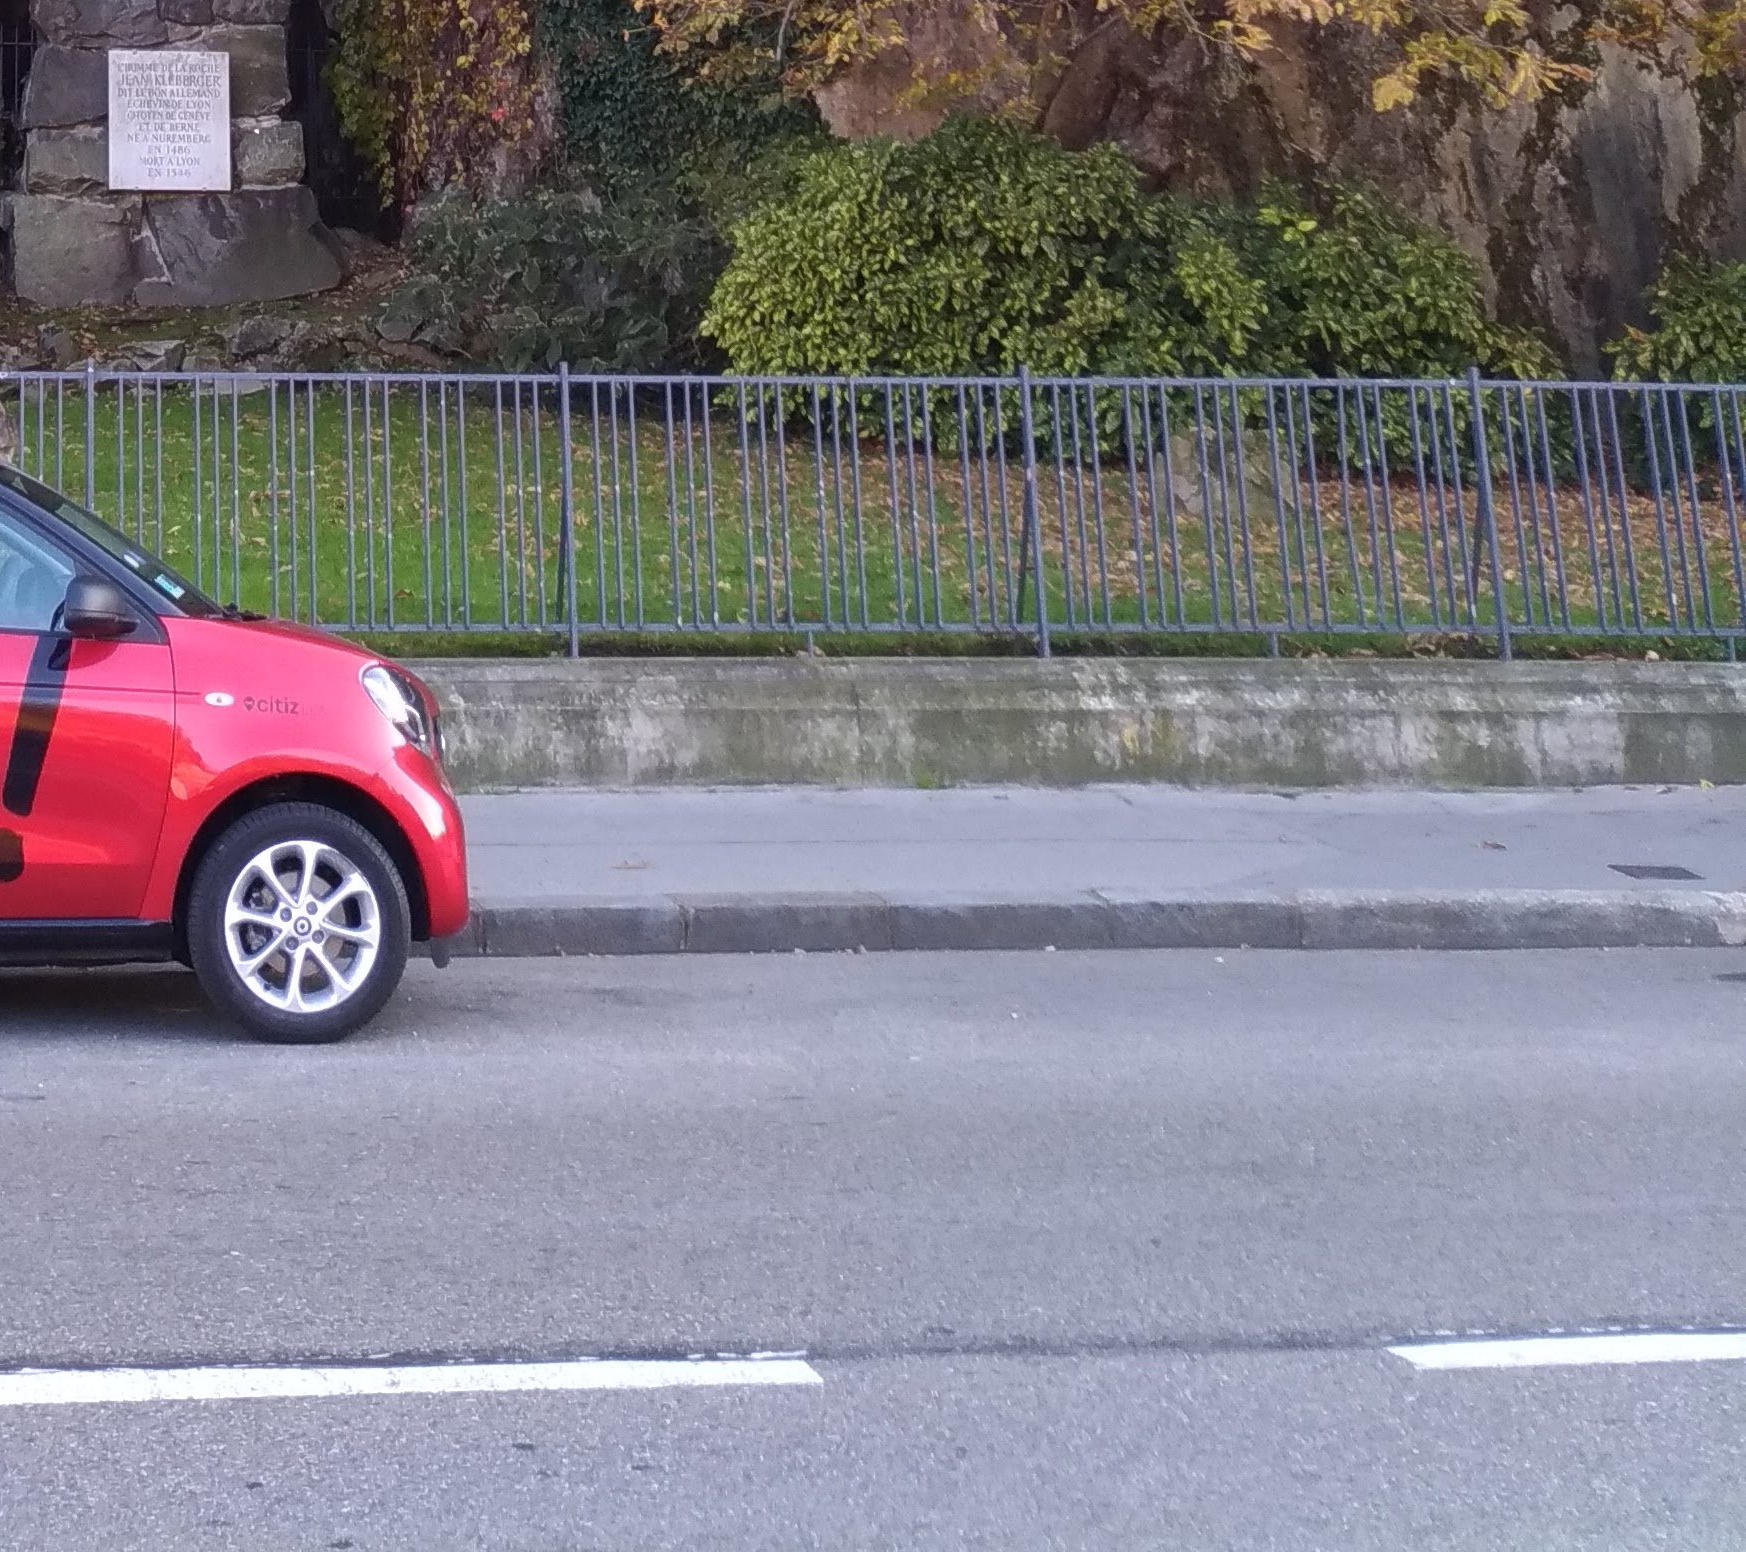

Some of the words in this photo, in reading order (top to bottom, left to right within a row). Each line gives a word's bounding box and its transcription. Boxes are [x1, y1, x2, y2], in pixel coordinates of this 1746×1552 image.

[161, 63, 174, 73] DE
[175, 63, 186, 73] LA
[188, 63, 220, 73] ROCHE
[117, 73, 149, 86] JEAN
[117, 87, 132, 97] DIT
[135, 88, 147, 97] LE
[148, 88, 168, 97] BON
[170, 88, 221, 98] ALLEMAND
[172, 99, 182, 109] DE
[186, 99, 211, 109] LYON
[127, 111, 164, 120] CITOYEN
[165, 111, 176, 120] DE
[139, 122, 151, 132] ET
[154, 122, 166, 132] DE
[169, 122, 200, 132] BERNE
[152, 134, 211, 144] NUREMBERG
[148, 145, 162, 154] EN
[166, 145, 191, 154] 1486
[140, 156, 164, 166] MORT
[176, 156, 200, 166] LYON
[148, 168, 162, 177] EN
[256, 696, 300, 715] citiz
